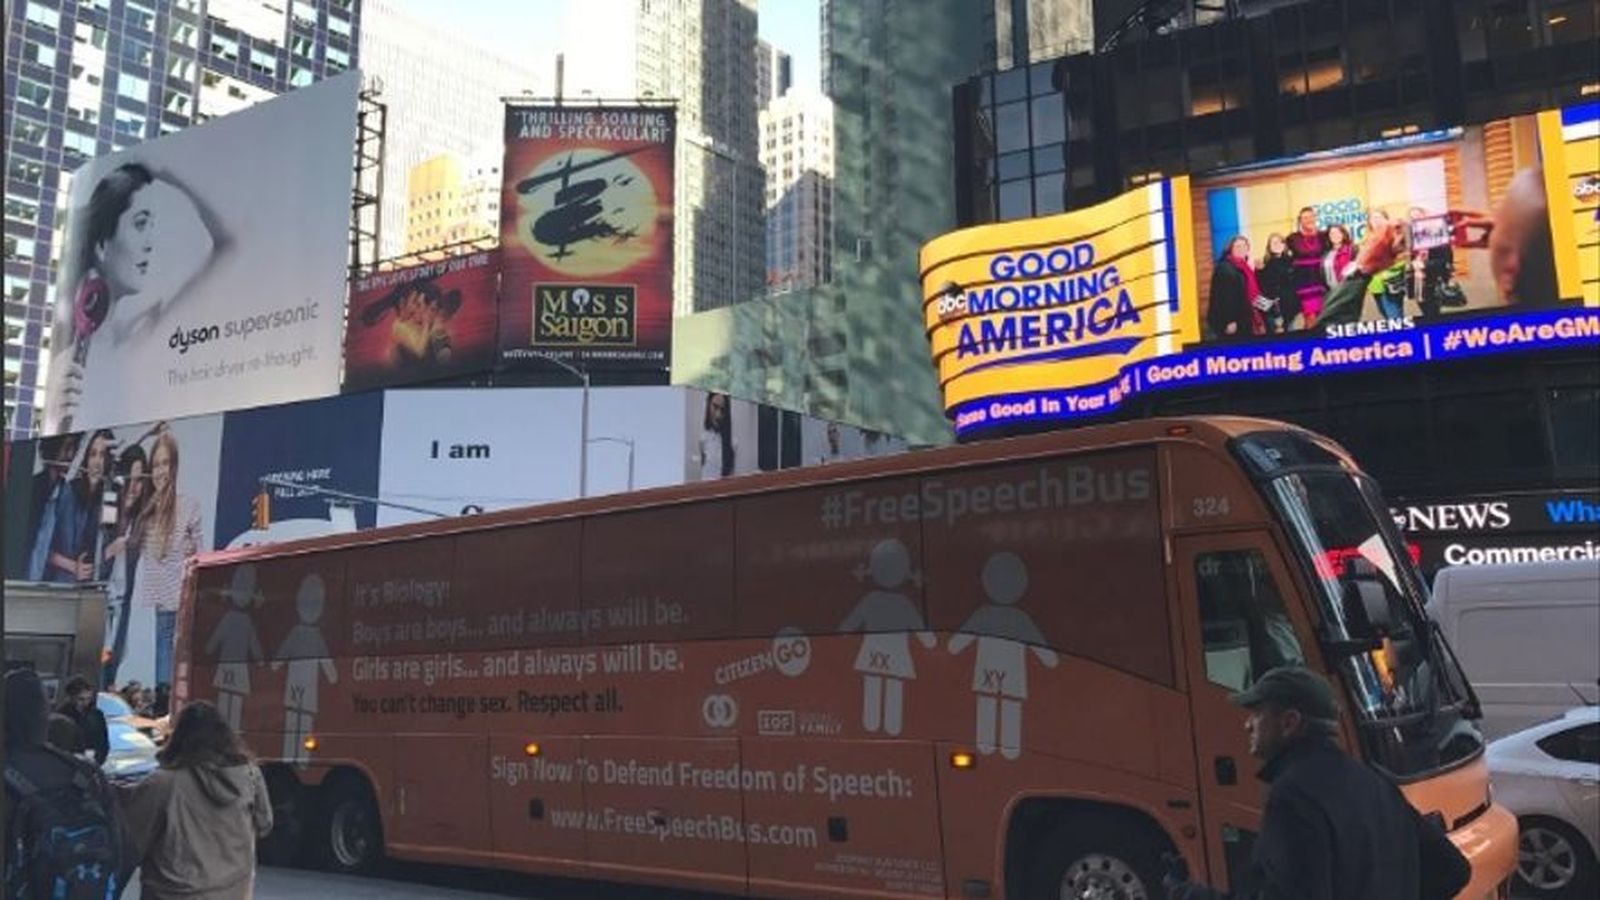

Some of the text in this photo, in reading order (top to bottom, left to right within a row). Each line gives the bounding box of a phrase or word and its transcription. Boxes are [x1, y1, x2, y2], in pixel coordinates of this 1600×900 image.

[519, 125, 551, 139] AND
[601, 111, 666, 127] SOARING
[989, 243, 1095, 281] GOOD
[938, 291, 966, 315] abc
[968, 266, 1121, 314] MORNING
[168, 298, 320, 354] dyson supersonic
[540, 312, 630, 342] Saigon
[958, 288, 1141, 360] AMERICA
[1325, 317, 1416, 339] SIEMENS
[1146, 341, 1414, 384] Good Morning America
[990, 398, 1037, 420] Good
[1041, 397, 1061, 414] In
[1066, 392, 1106, 412] Your
[431, 440, 491, 459] I am
[820, 466, 1151, 528] #FreeSpeechBus
[1192, 495, 1232, 518] 324
[1408, 502, 1511, 531] NEWS
[352, 621, 392, 648] Boys
[395, 622, 423, 641] are
[488, 608, 524, 636] and
[528, 603, 602, 635] always
[607, 596, 649, 627] will
[653, 595, 690, 626] be.
[352, 655, 390, 682] Girls
[392, 659, 422, 681] are
[482, 649, 519, 680] and
[523, 648, 598, 683] always
[602, 644, 643, 674] will
[648, 642, 685, 674] be.
[714, 639, 807, 685] CITIZEN GO
[868, 651, 891, 670] XX
[982, 667, 1007, 690] XY
[352, 692, 379, 714] You
[419, 691, 476, 721] change
[479, 695, 512, 714] sex.
[517, 689, 590, 718] Respect
[594, 683, 625, 713] all.
[491, 755, 914, 802] Sign Now To Defend Freedom of Speech:
[551, 806, 819, 849] www.FreeSpeechBus.com
